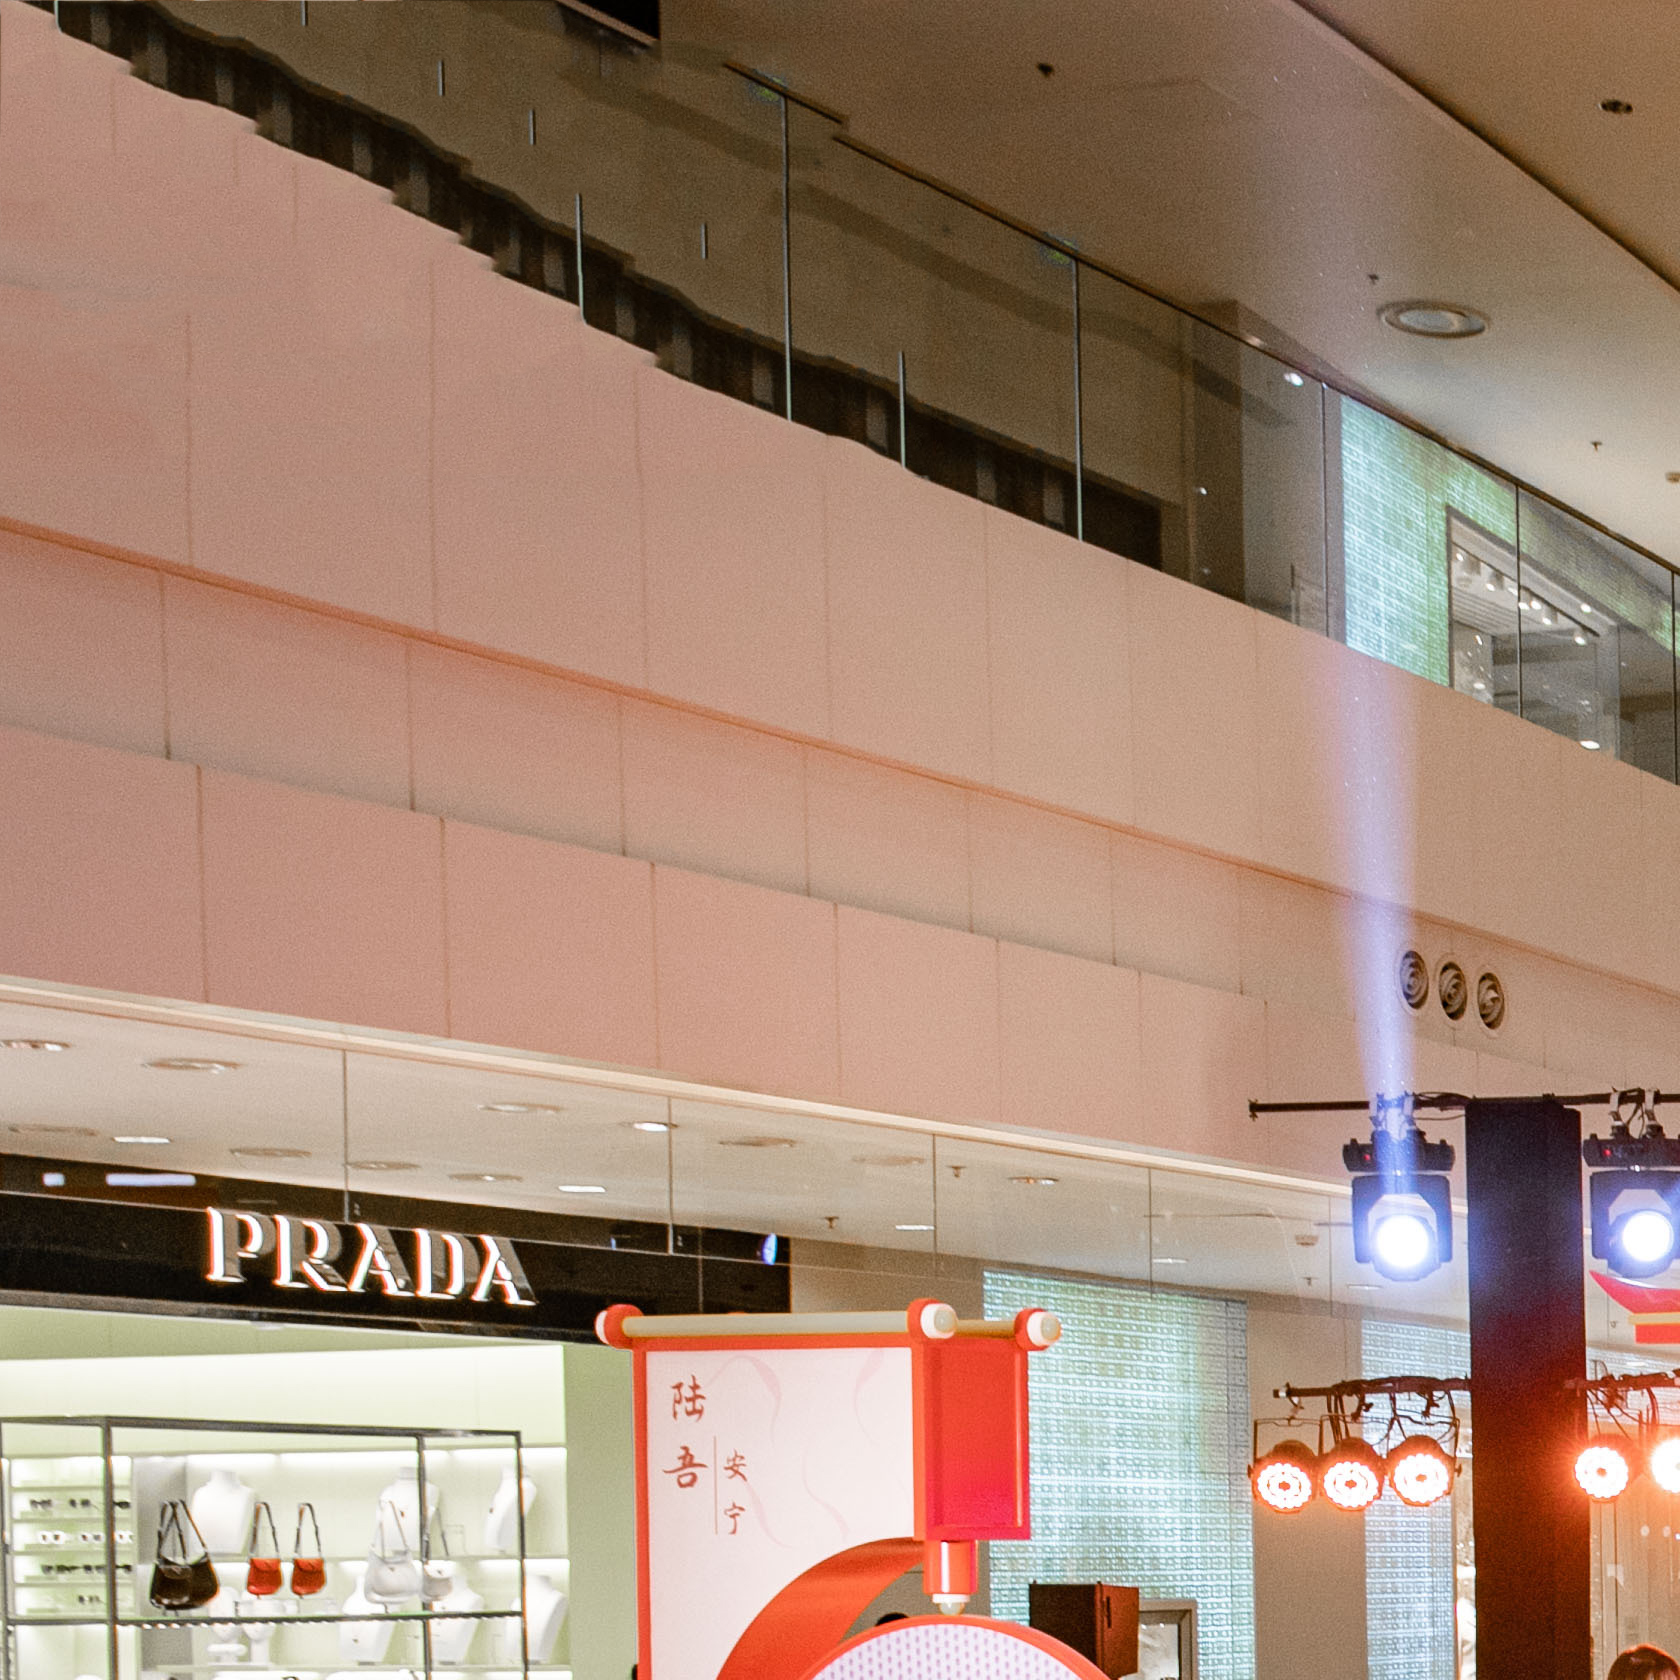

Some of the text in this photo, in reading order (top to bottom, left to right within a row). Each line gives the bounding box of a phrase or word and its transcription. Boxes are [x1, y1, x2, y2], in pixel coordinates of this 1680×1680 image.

[205, 1206, 538, 1306] PRADA
[662, 1374, 709, 1489] 陆吾
[722, 1449, 749, 1536] 安宁
